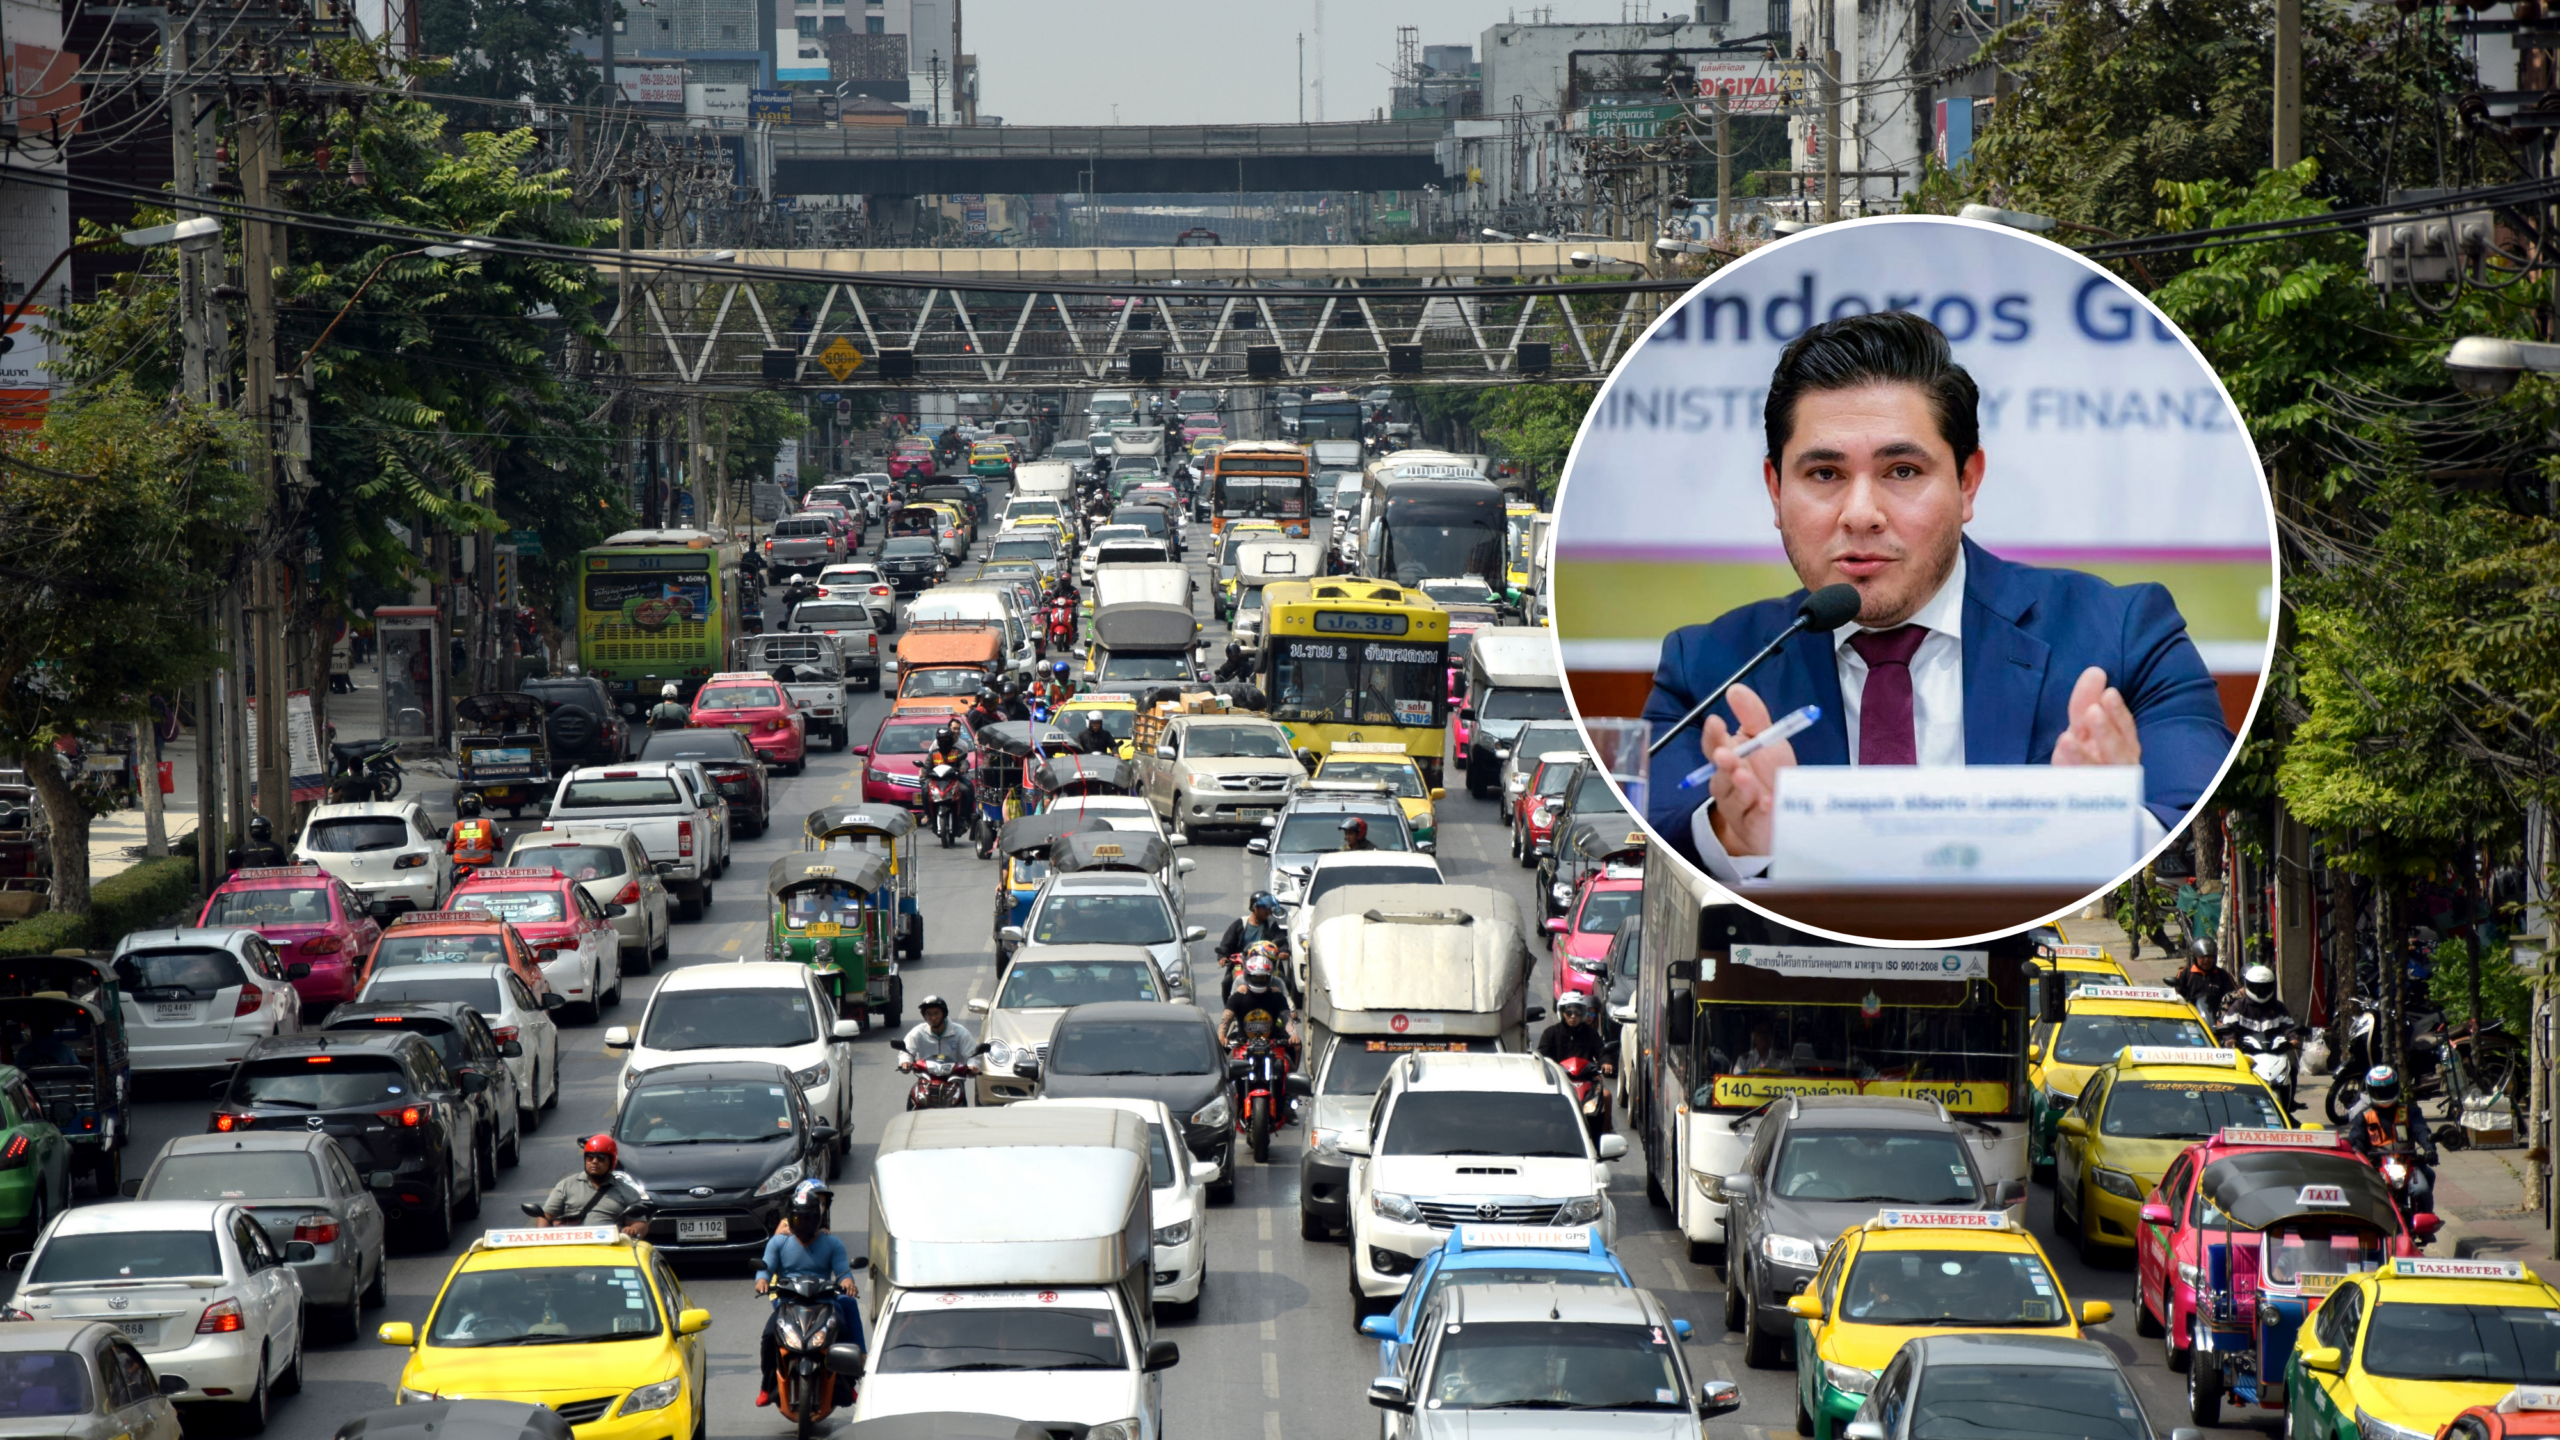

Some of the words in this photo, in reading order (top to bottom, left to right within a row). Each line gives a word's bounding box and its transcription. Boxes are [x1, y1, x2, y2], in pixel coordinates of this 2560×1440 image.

[1700, 77, 1778, 97] DIGITAL
[639, 558, 661, 568] 511
[1327, 615, 1393, 632] ปอ.38
[1290, 643, 1333, 660] ม.ราม
[1337, 646, 1347, 660] 2
[1099, 846, 1118, 854] TAXI
[249, 868, 302, 878] TAXI-METER
[489, 868, 537, 877] TAXI-METER
[416, 911, 471, 921] TAXI-METER
[1754, 951, 1852, 973] รถสายนี้ได้รับการรับรองคุณภาพ
[1854, 960, 1883, 973] มาตรฐาน
[1886, 960, 1898, 971] ISO
[1901, 961, 1938, 971] 9001:2008
[2100, 989, 2159, 998] TAXI-METER
[174, 1003, 192, 1011] 4497
[1394, 1019, 1406, 1028] AP
[2147, 1051, 2214, 1061] TAXI-METER
[1720, 1082, 1751, 1098] 140
[2237, 1132, 2313, 1143] TAXI-METER
[2307, 1189, 2339, 1201] TAXI
[1901, 1214, 1987, 1225] TAXI-METER
[699, 1221, 722, 1232] 1102
[506, 1231, 594, 1242] TAXI-METER
[2417, 1264, 2503, 1275] TAXI-METER
[1040, 1293, 1056, 1302] 23
[2543, 1393, 2560, 1406] T
